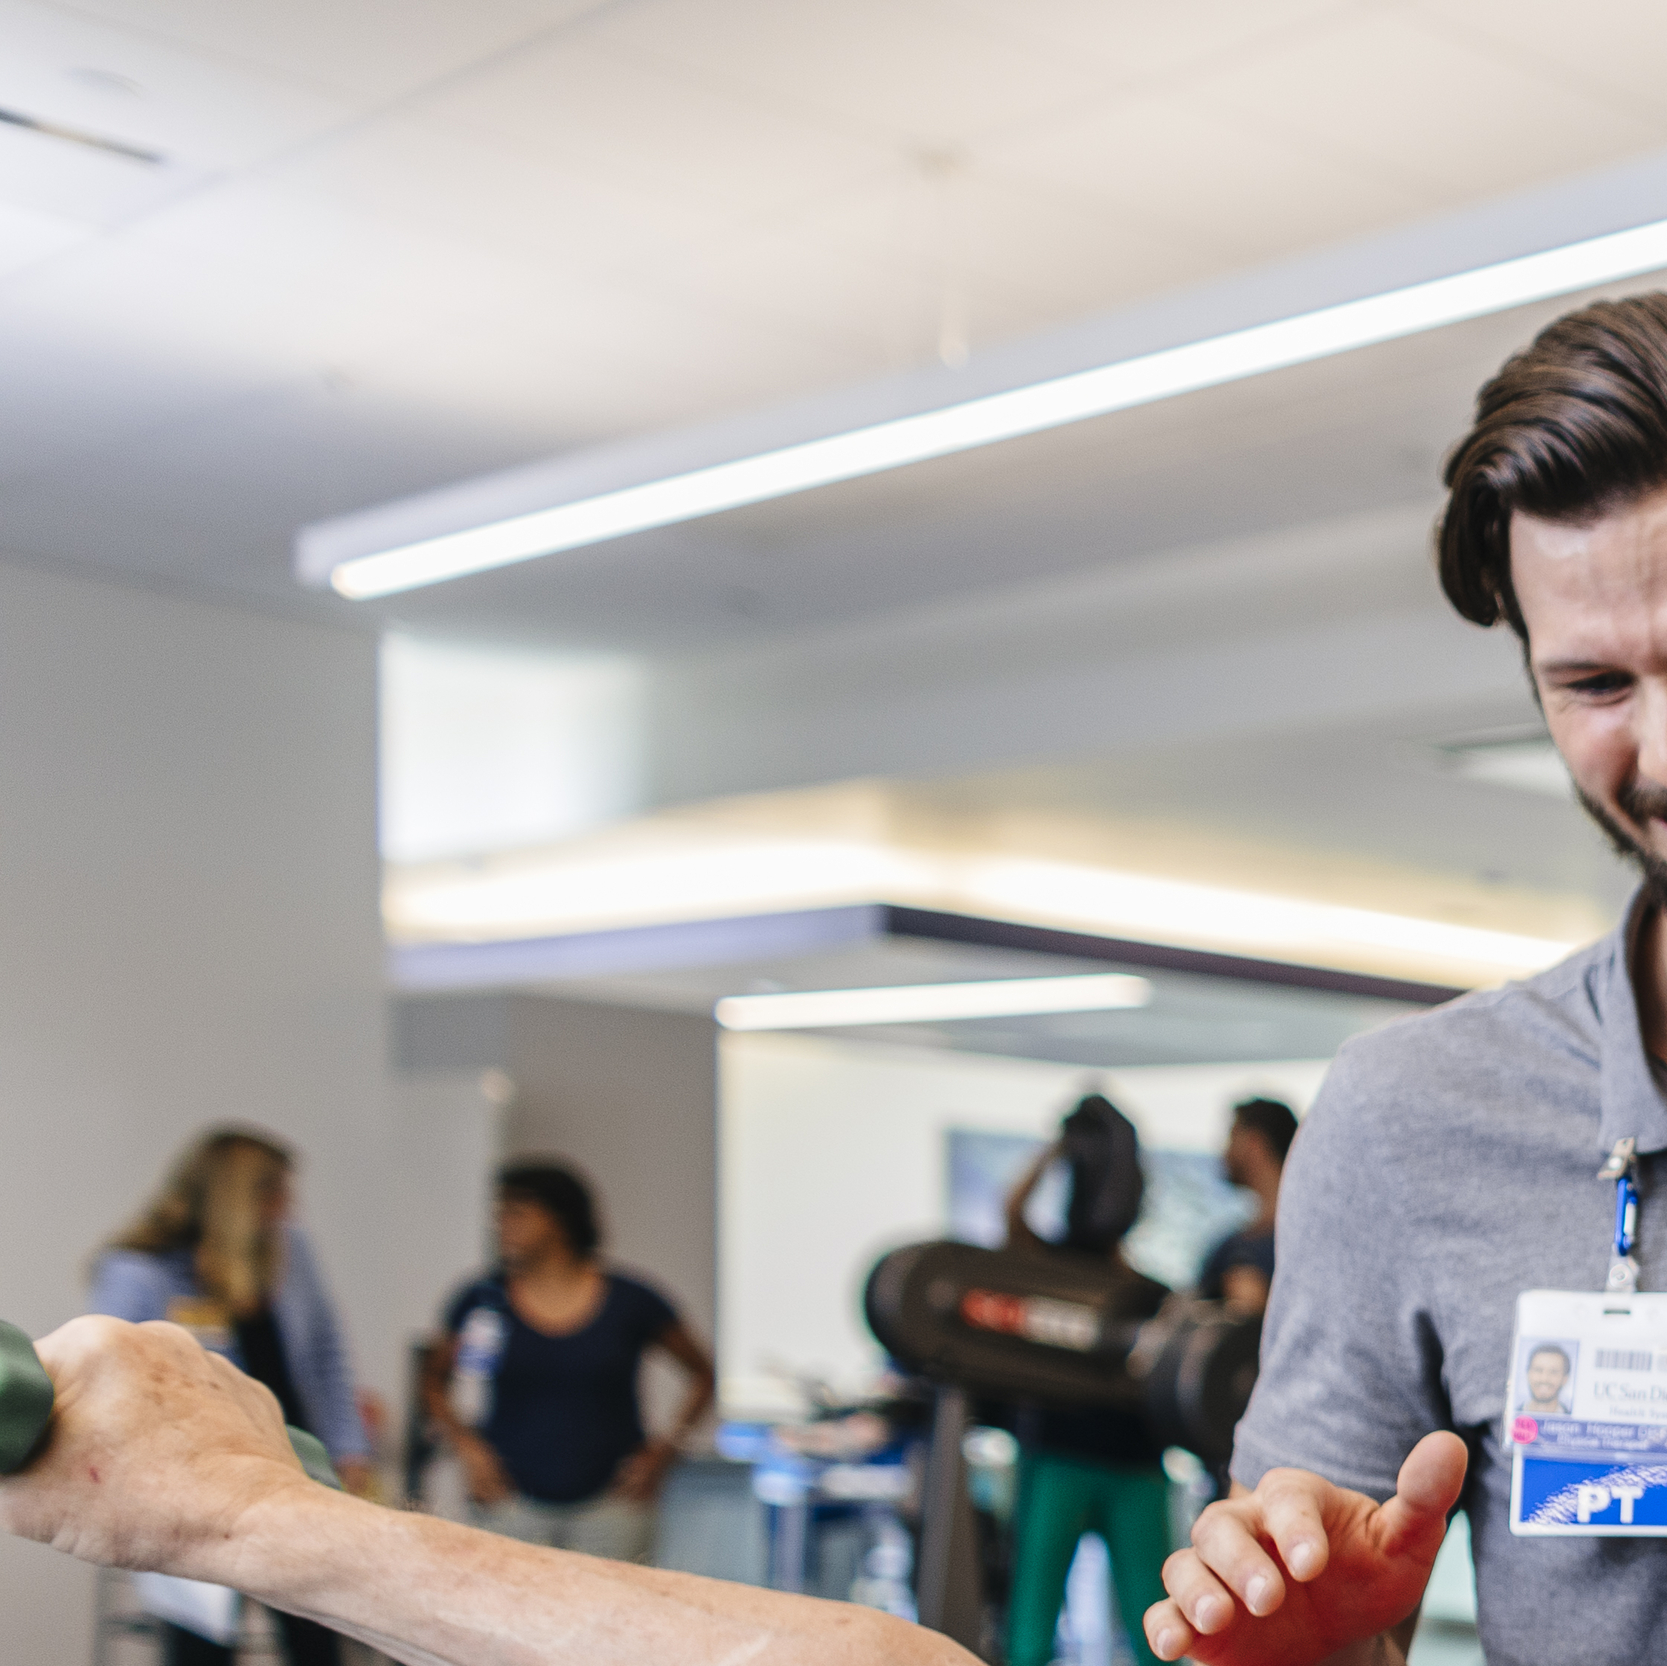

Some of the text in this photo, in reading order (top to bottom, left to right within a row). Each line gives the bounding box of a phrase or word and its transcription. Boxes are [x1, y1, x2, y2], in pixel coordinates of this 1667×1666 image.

[1593, 1381, 1617, 1401] UC
[1619, 1382, 1647, 1402] San
[1576, 1485, 1644, 1524] PT
